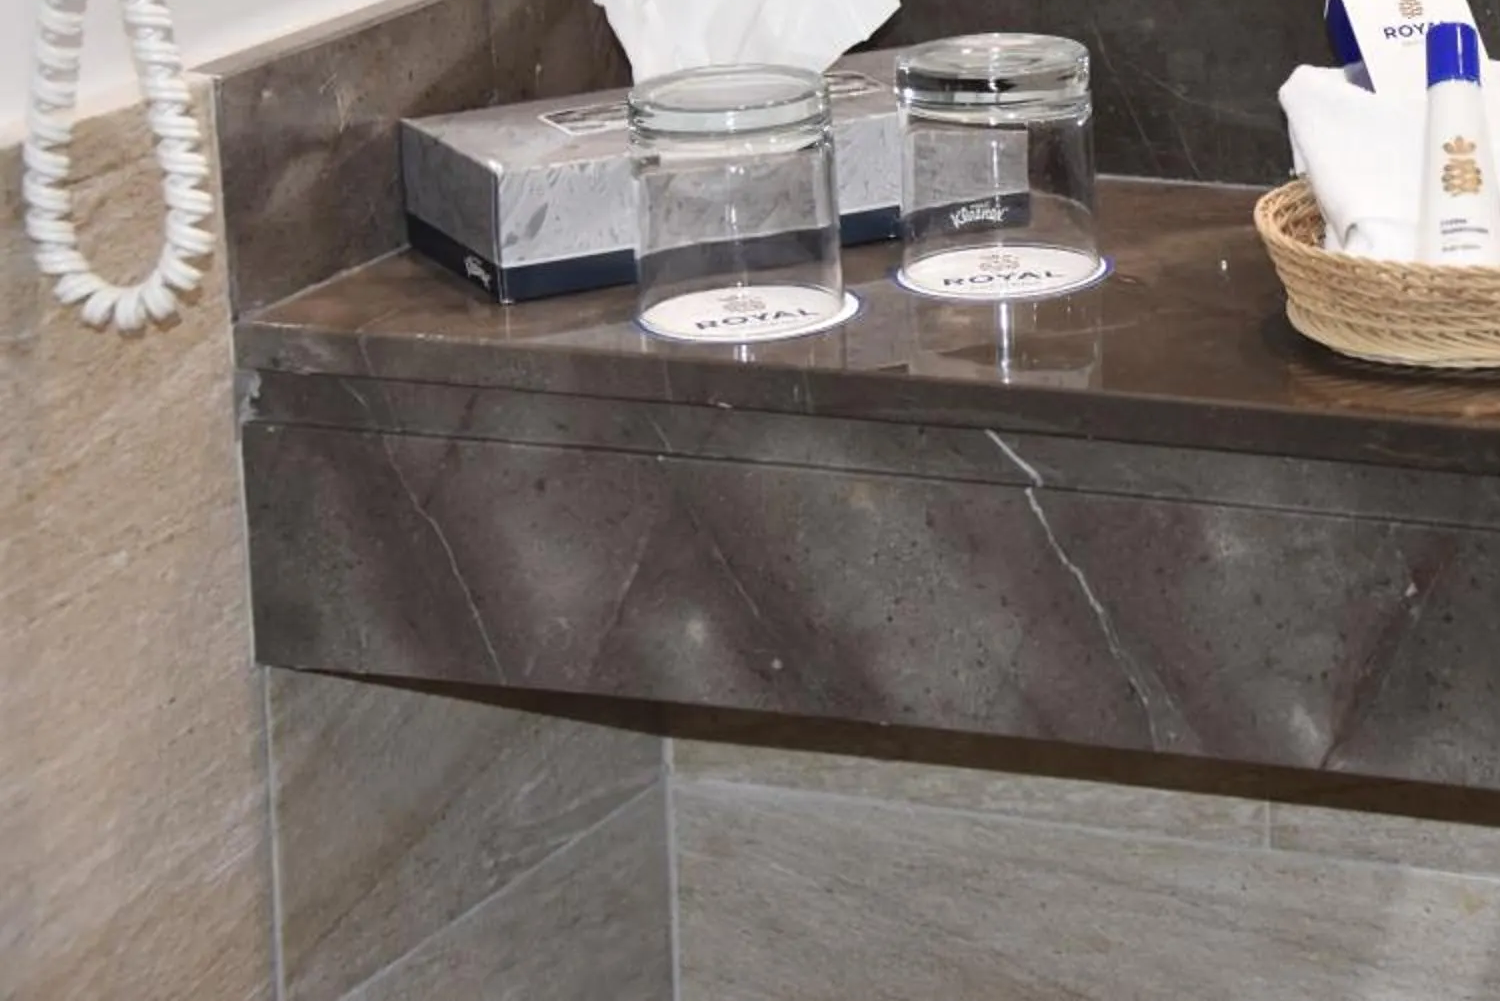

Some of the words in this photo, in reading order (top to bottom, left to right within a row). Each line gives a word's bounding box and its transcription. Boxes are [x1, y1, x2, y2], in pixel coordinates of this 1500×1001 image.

[1383, 21, 1440, 40] ROY
[943, 271, 1067, 286] ROYAL
[695, 309, 820, 330] ROYAL
